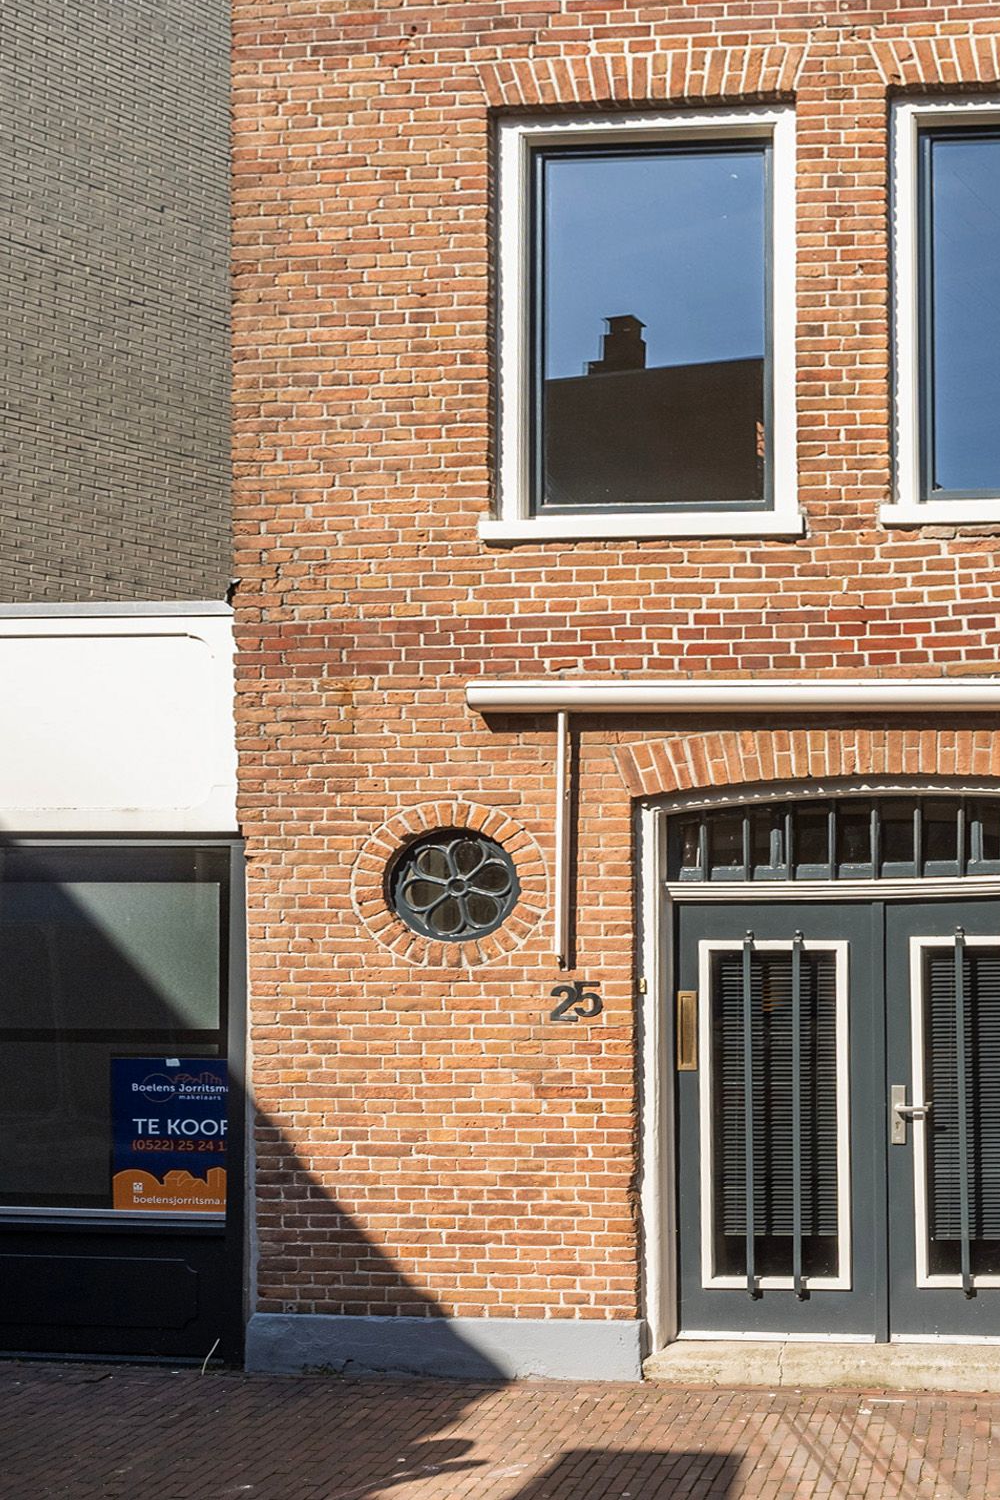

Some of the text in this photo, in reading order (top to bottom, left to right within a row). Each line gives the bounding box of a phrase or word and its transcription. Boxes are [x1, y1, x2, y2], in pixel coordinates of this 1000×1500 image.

[550, 981, 603, 1021] 25
[132, 1083, 175, 1092] Boelens
[132, 1118, 160, 1135] TE
[132, 1139, 174, 1151] (0522)
[178, 1140, 194, 1151] 25
[198, 1140, 214, 1152] 24
